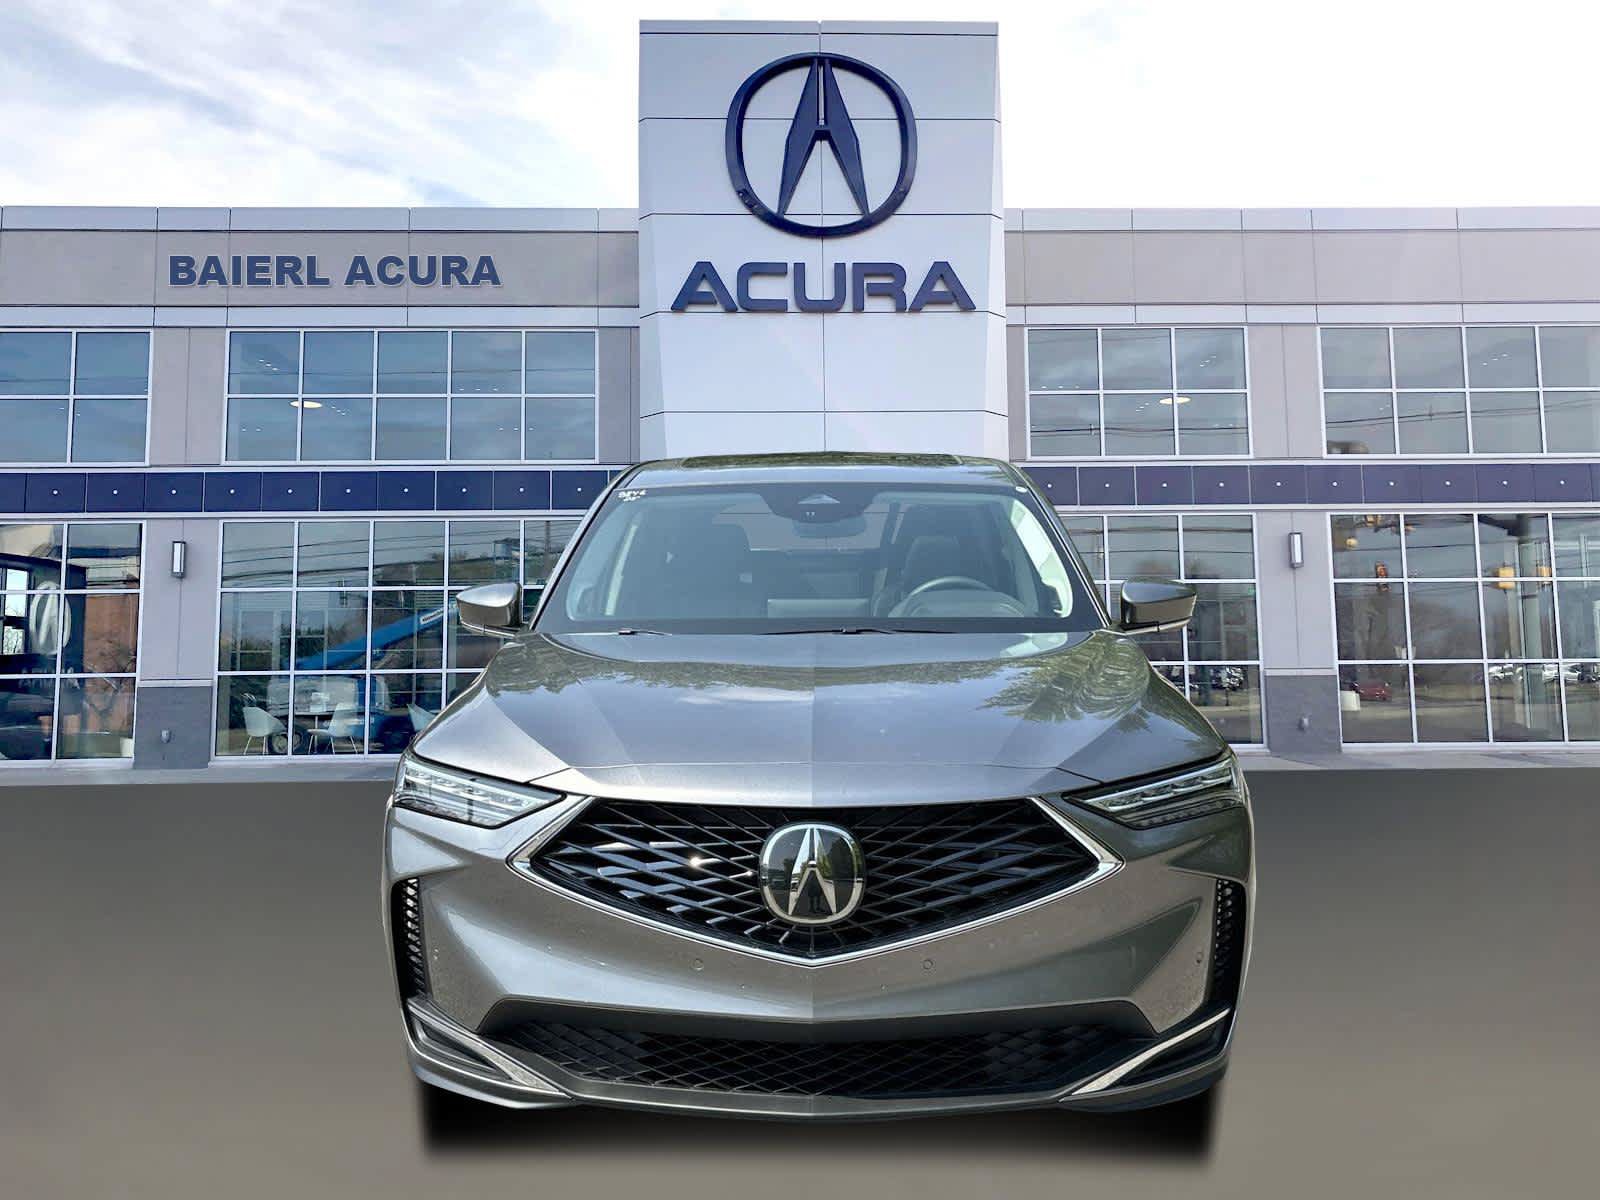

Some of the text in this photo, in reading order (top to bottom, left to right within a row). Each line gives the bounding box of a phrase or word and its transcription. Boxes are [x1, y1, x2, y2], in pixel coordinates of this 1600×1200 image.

[169, 254, 502, 287] BAIERL ACURA
[670, 260, 977, 313] ACURA
